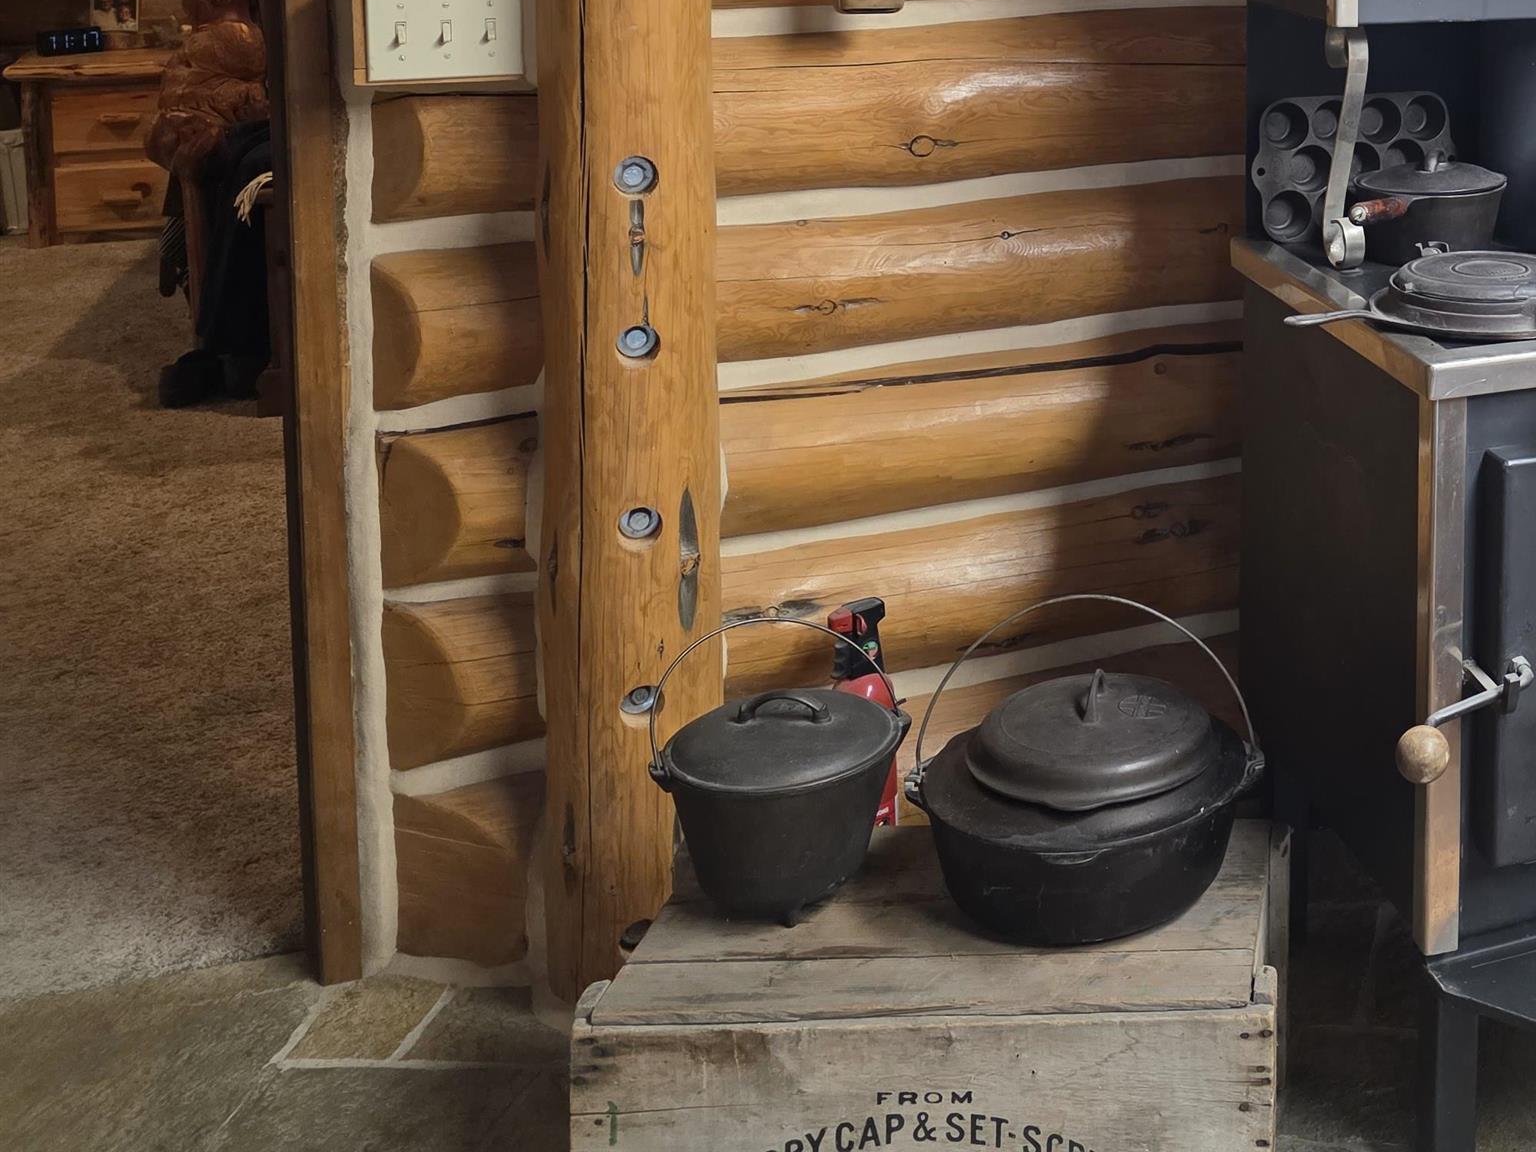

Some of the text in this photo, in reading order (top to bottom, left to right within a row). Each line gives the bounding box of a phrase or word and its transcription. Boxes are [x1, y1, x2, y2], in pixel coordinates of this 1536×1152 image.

[49, 30, 99, 50] 11:17
[876, 1090, 974, 1105] FROM
[835, 1113, 905, 1152] CAP
[912, 1111, 937, 1143] &
